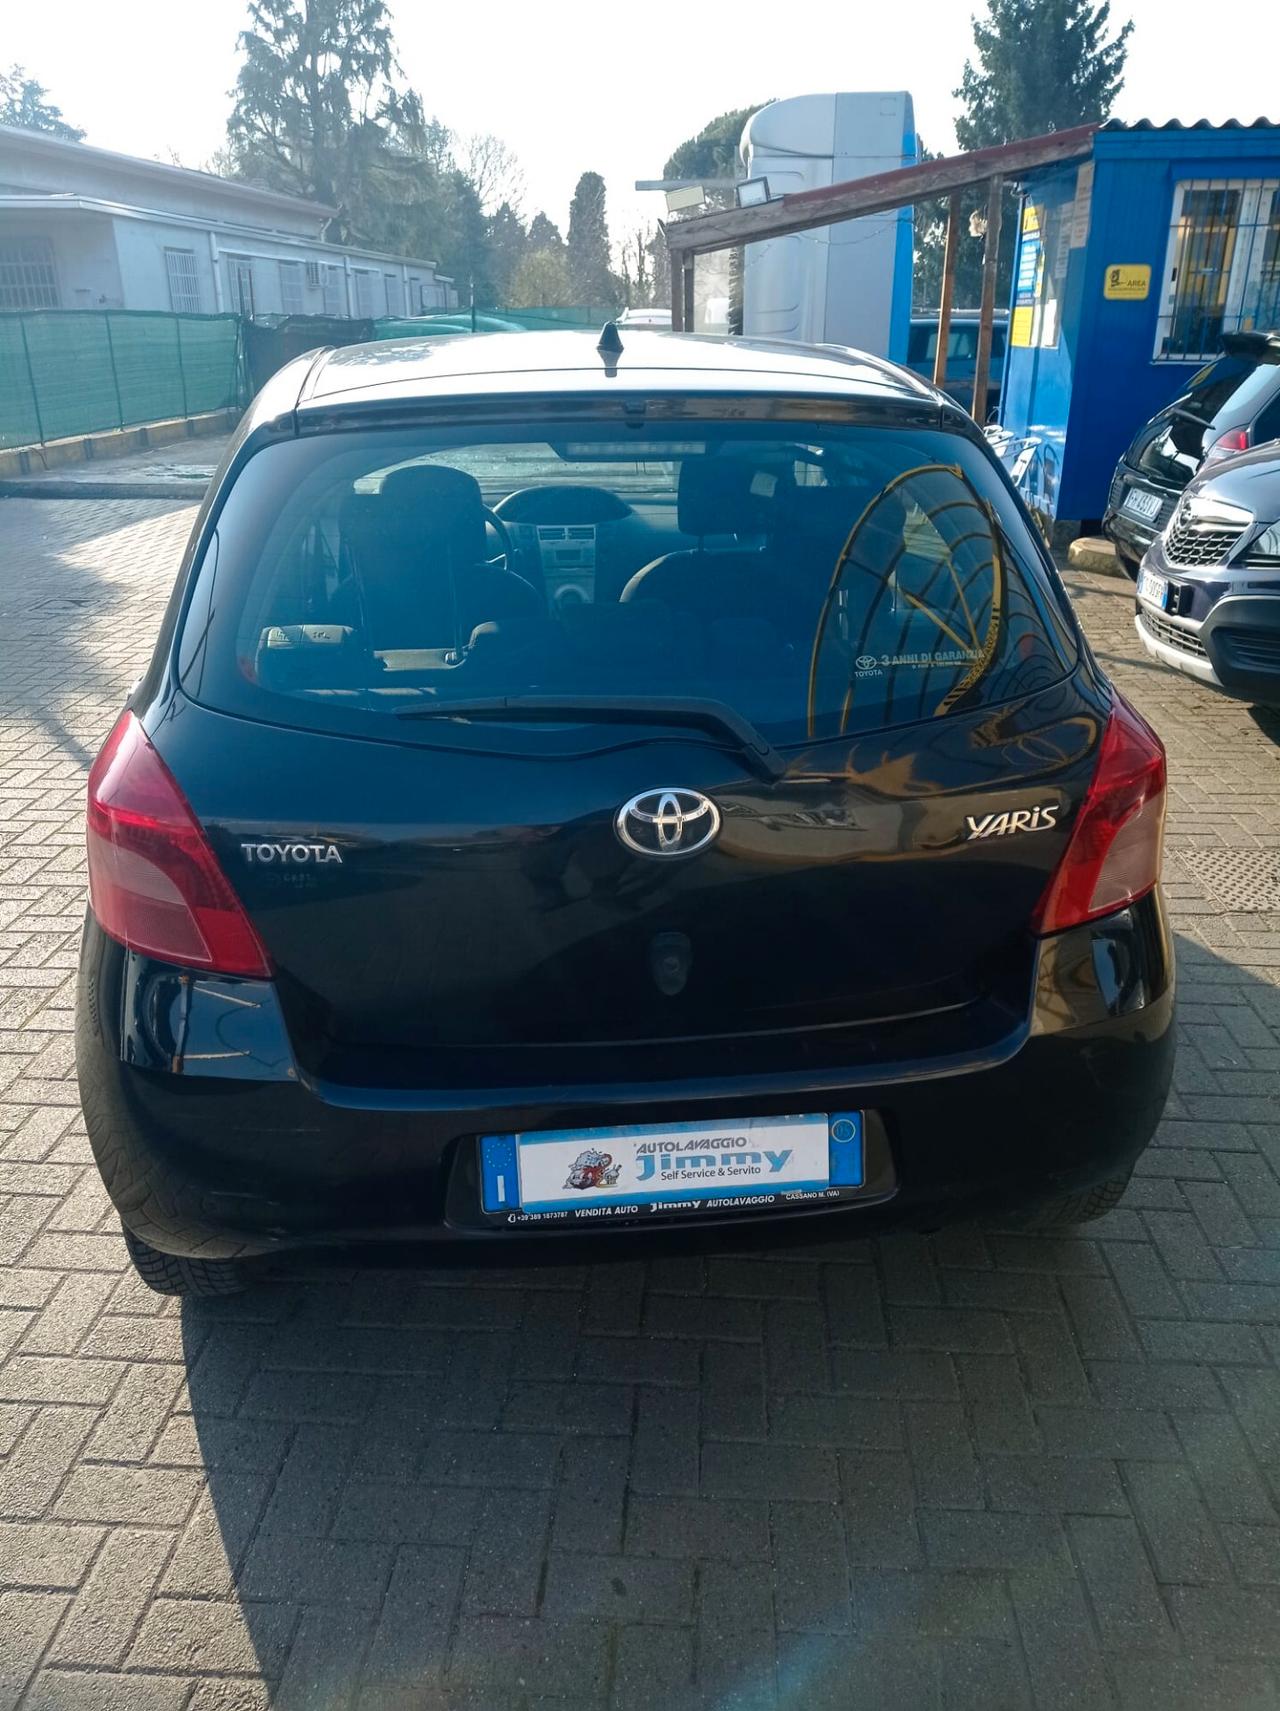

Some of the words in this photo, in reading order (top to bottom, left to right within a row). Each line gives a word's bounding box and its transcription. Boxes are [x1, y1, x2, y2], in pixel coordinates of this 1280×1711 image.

[881, 654, 890, 666] 3
[892, 655, 918, 665] ANNI
[921, 652, 932, 662] DI
[934, 649, 985, 661] GARANZIA
[854, 669, 883, 678] TOYOTA
[241, 843, 343, 864] TOYOTA
[636, 1136, 748, 1154] AUTOLAVAGGIO
[660, 1170, 679, 1181] Self
[681, 1168, 716, 1179] Service
[719, 1167, 726, 1177] &
[727, 1164, 762, 1176] Servito
[706, 1195, 775, 1208] AUTOLAVAGGIO
[785, 1191, 818, 1200] CASSANO
[826, 1189, 840, 1198] (VA)
[575, 1207, 612, 1218] VENDITA
[614, 1205, 639, 1215] AUTO
